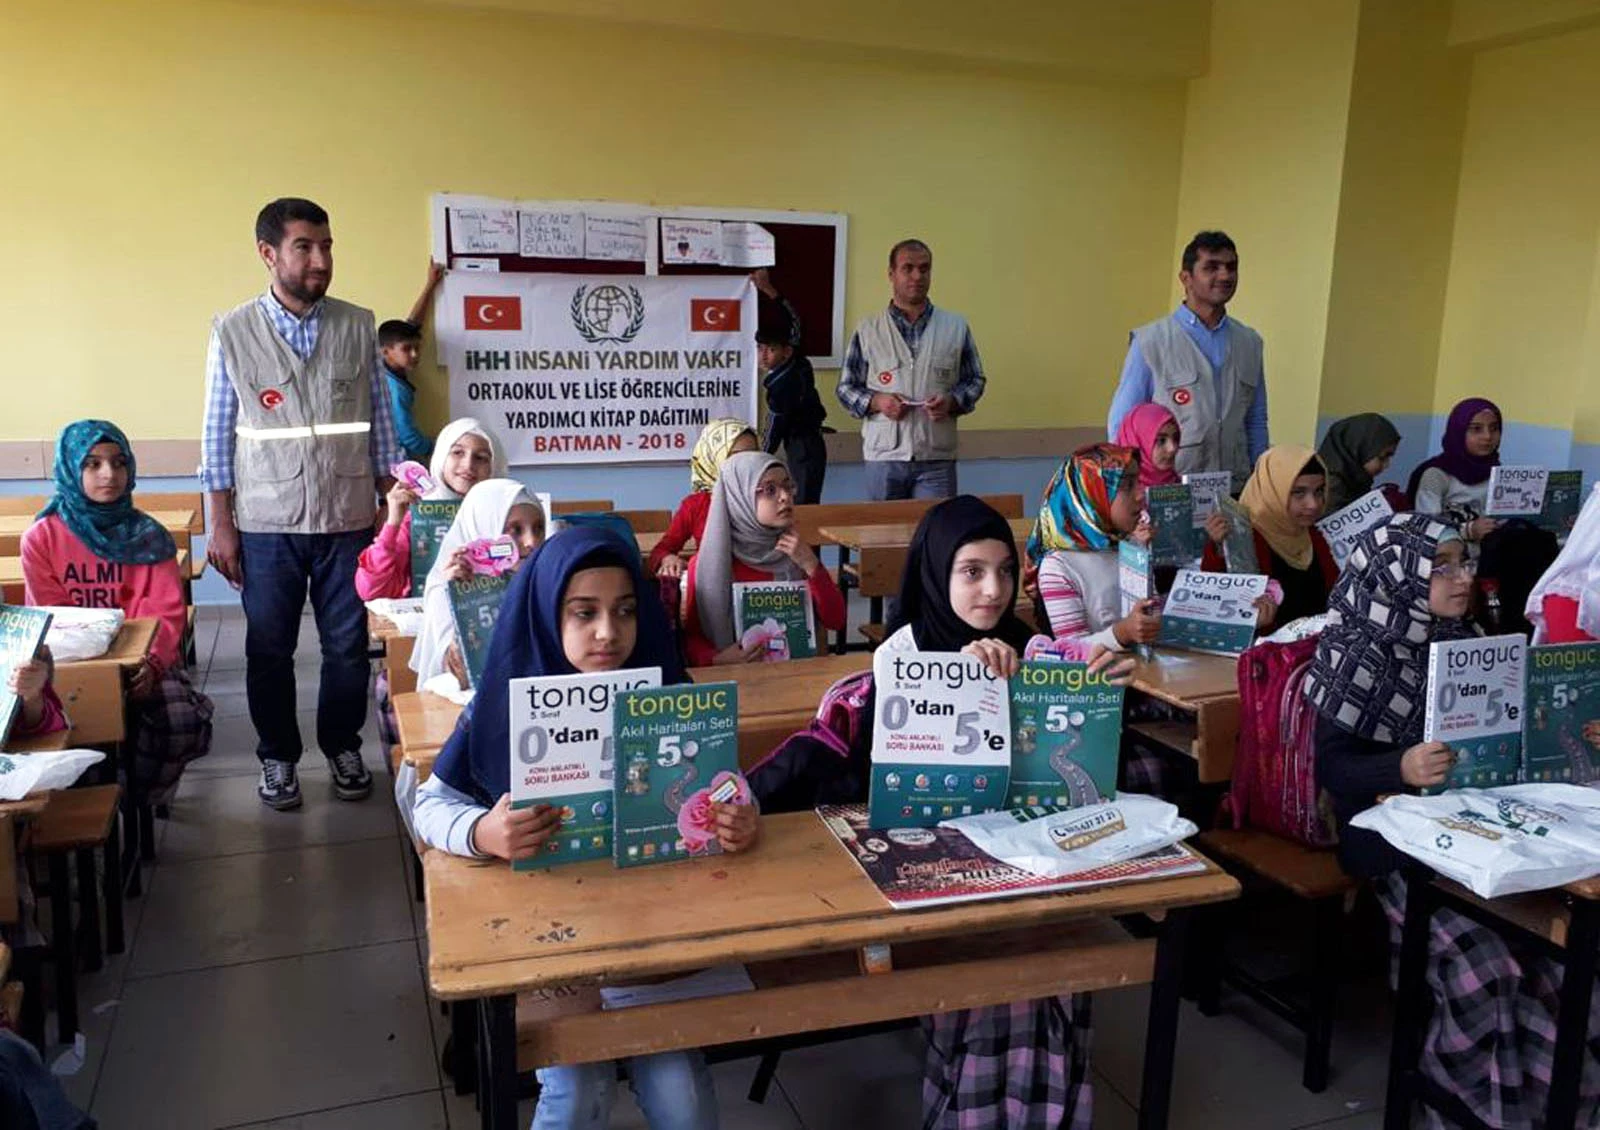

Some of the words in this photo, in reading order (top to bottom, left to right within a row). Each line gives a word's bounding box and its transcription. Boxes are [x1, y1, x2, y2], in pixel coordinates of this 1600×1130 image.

[596, 351, 678, 370] YARDIM
[684, 351, 741, 369] VAKFI
[468, 382, 556, 400] ORTAOKUL
[561, 382, 580, 400] VE
[585, 378, 617, 400] LİSE
[621, 377, 741, 399] ÖĞRENCİLERİNE
[505, 411, 585, 429] YARDIMCI
[591, 407, 635, 428] KİTAP
[640, 406, 709, 427] DAĞITIMI
[534, 434, 621, 452] BATMAN
[639, 433, 685, 450] 2018
[69, 588, 119, 608] GIRL
[479, 605, 493, 628] 5
[1097, 692, 1120, 704] Seti
[710, 715, 734, 730] Seti
